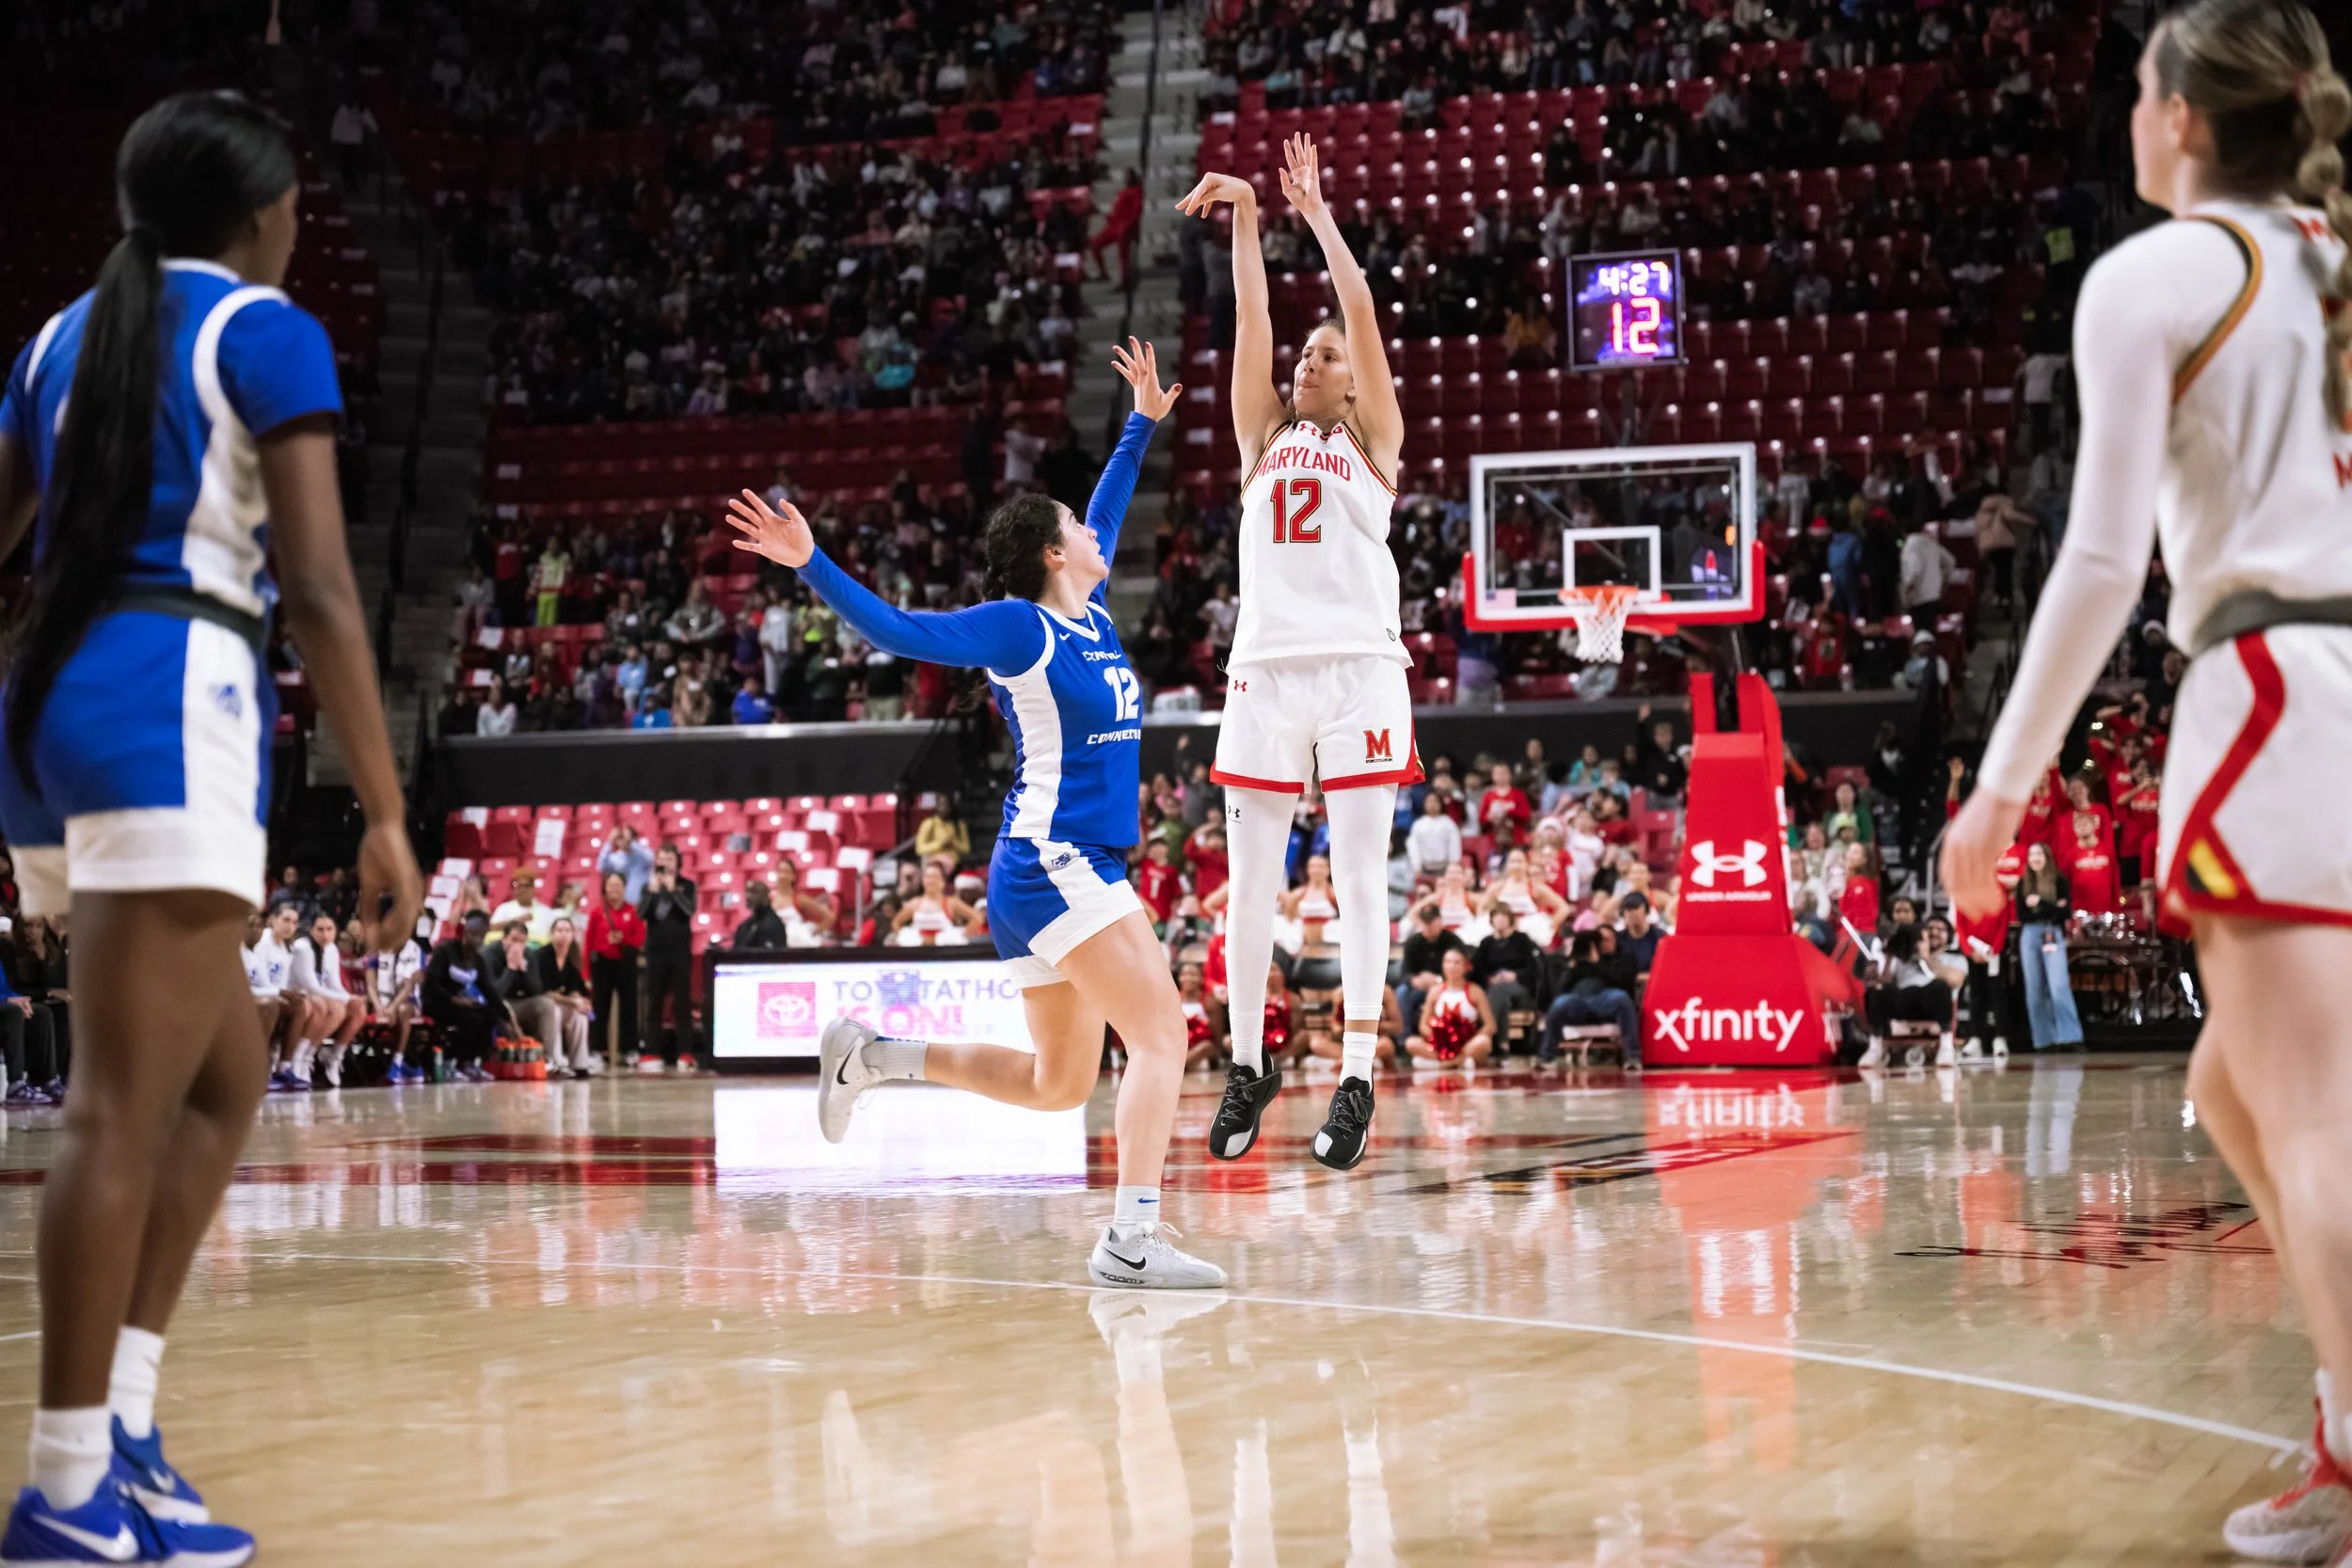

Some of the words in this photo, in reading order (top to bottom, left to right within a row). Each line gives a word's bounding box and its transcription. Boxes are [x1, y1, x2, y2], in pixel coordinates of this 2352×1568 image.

[1598, 261, 1669, 296] 4:27
[1612, 297, 1661, 355] 12
[1258, 446, 1351, 482] MARYLAND
[1270, 478, 1322, 544] 12
[1104, 666, 1140, 722] 12
[1362, 728, 1392, 760] M
[1653, 996, 1804, 1053] xfinity
